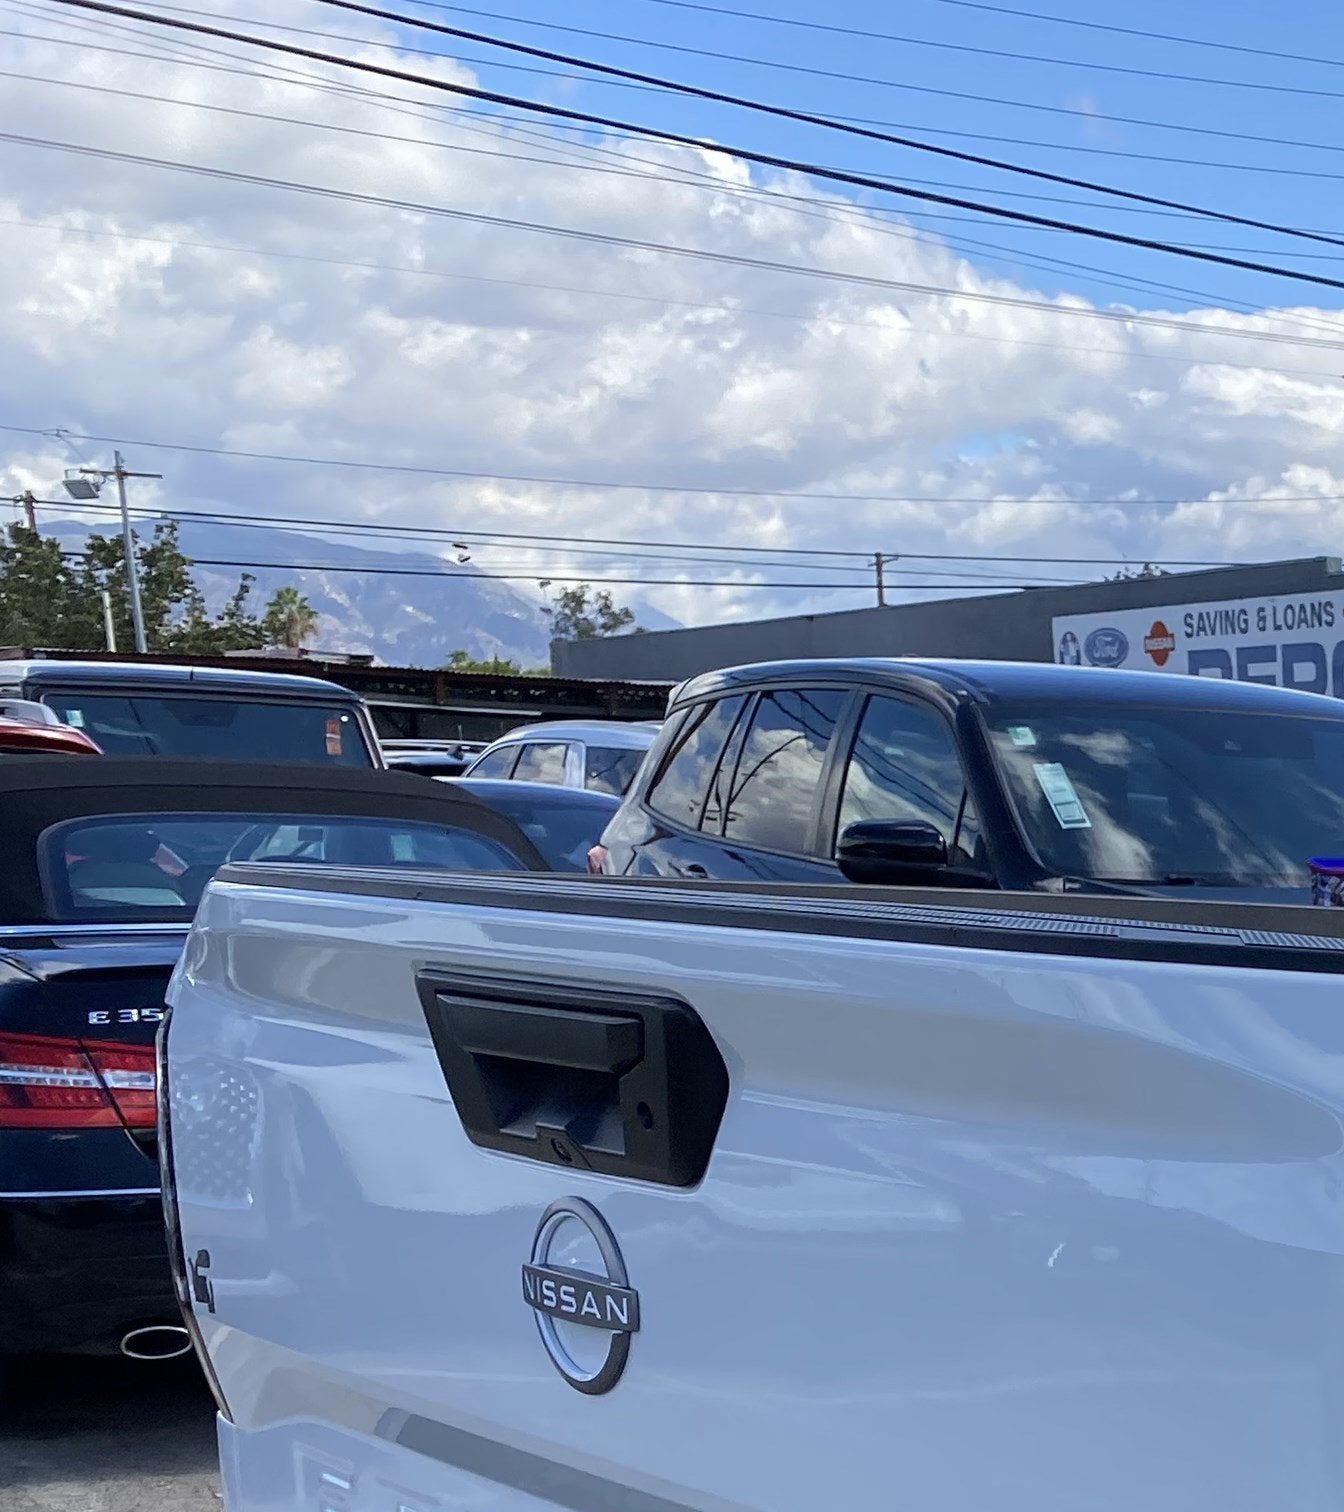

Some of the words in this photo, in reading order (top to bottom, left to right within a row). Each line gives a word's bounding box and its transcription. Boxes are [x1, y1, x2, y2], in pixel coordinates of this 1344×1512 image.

[1184, 608, 1248, 638] SAVING
[1257, 609, 1267, 631] &
[1273, 601, 1335, 631] LOANS
[524, 1272, 629, 1325] NISSAN
